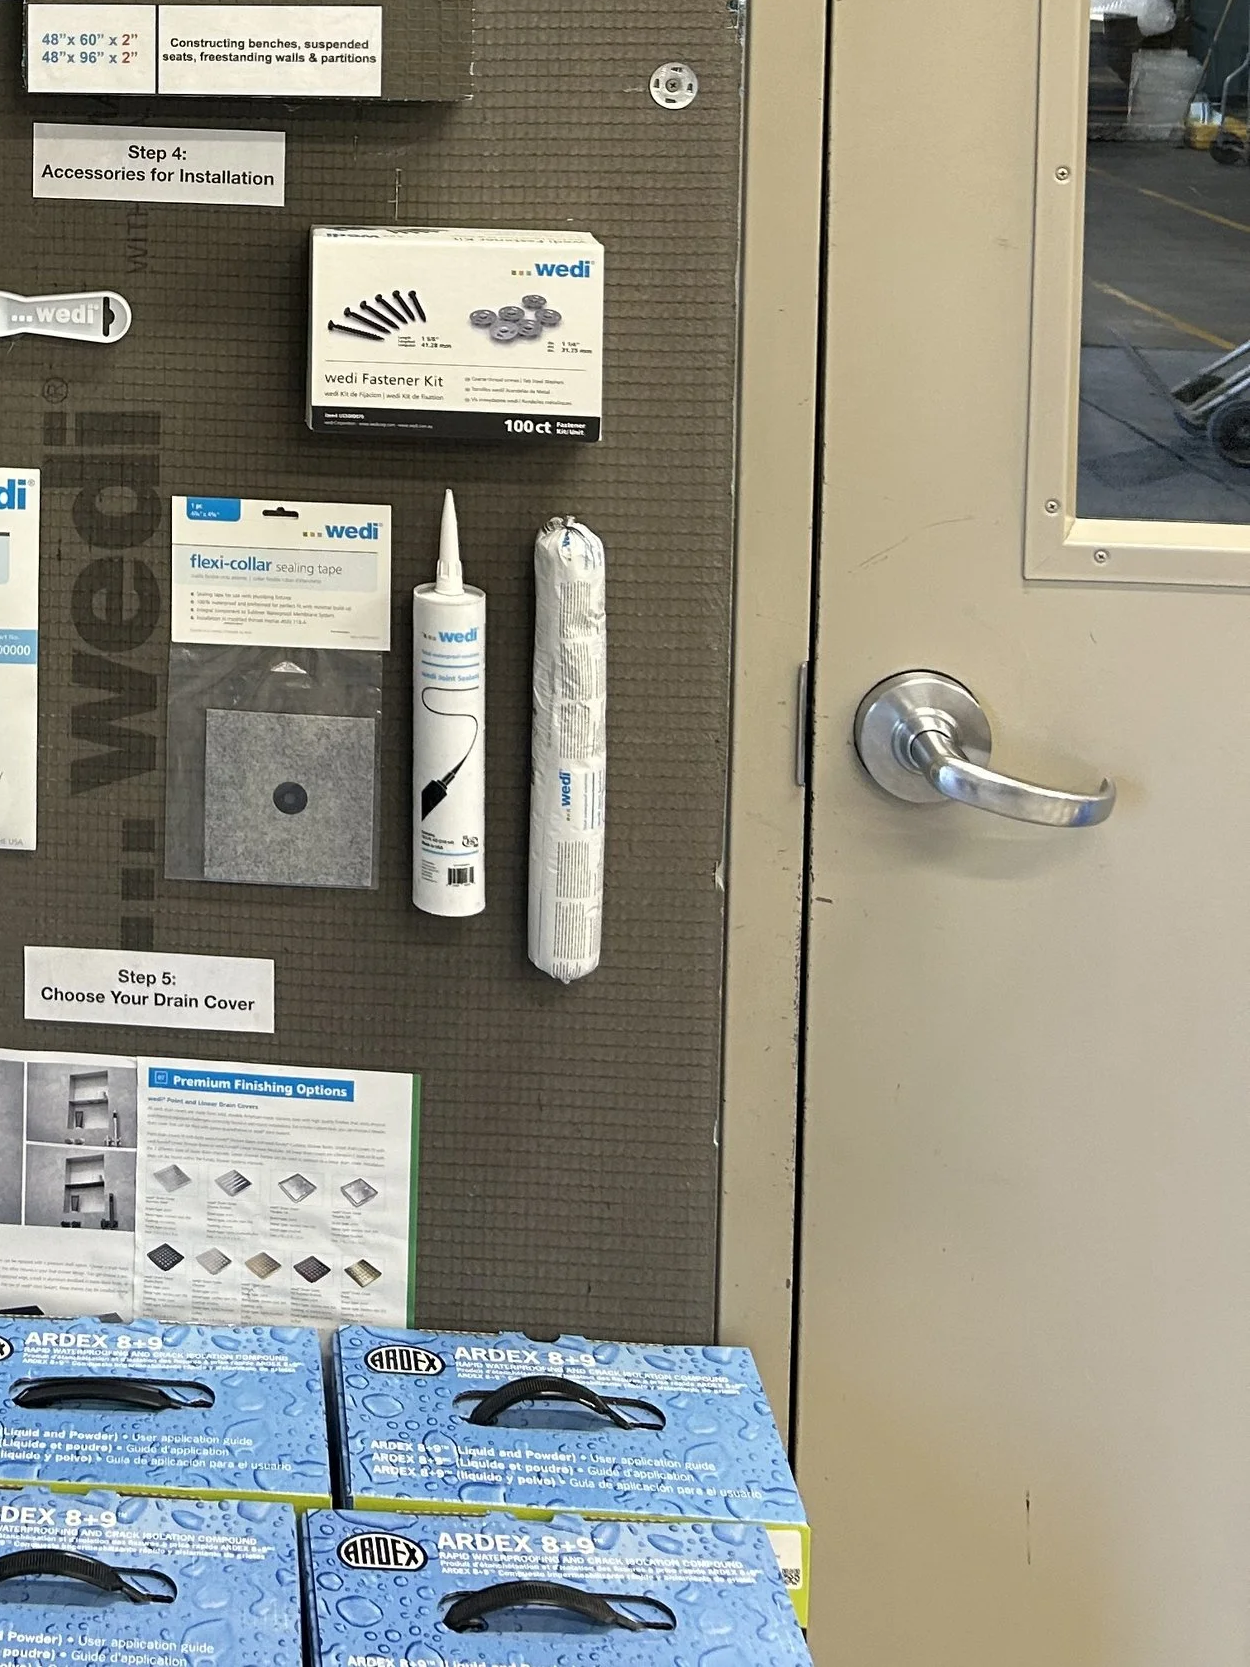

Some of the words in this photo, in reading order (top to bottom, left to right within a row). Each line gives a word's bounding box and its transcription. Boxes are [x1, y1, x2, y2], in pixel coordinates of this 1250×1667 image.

[163, 52, 196, 63] seats,
[200, 52, 272, 64] freestanding
[275, 53, 305, 62] walls
[309, 53, 318, 63] &
[322, 54, 377, 65] partitions
[128, 145, 167, 163] Step
[172, 147, 186, 160] 4:
[42, 164, 145, 181] Accessories
[150, 168, 175, 182] for
[180, 169, 274, 185] Installation
[325, 373, 357, 384] wedi
[363, 373, 420, 386] Fastener
[425, 376, 443, 387] Kit
[504, 419, 533, 433] 100
[535, 421, 552, 434] ct
[190, 554, 272, 572] flexi-collar
[276, 562, 314, 576] sealing
[318, 564, 342, 576] tape
[439, 628, 478, 643] wedi
[118, 970, 156, 987] Step
[162, 972, 176, 985] 5:
[42, 987, 105, 1003] Choose
[111, 991, 149, 1005] Your
[154, 993, 198, 1008] Drain
[204, 996, 255, 1011] Cover
[174, 1076, 231, 1089] Premium
[234, 1080, 293, 1096] Finishing
[297, 1084, 347, 1097] Options
[370, 1350, 439, 1373] ARDEX
[344, 1537, 423, 1566] ARDEX
[437, 1533, 532, 1553] ARDEX
